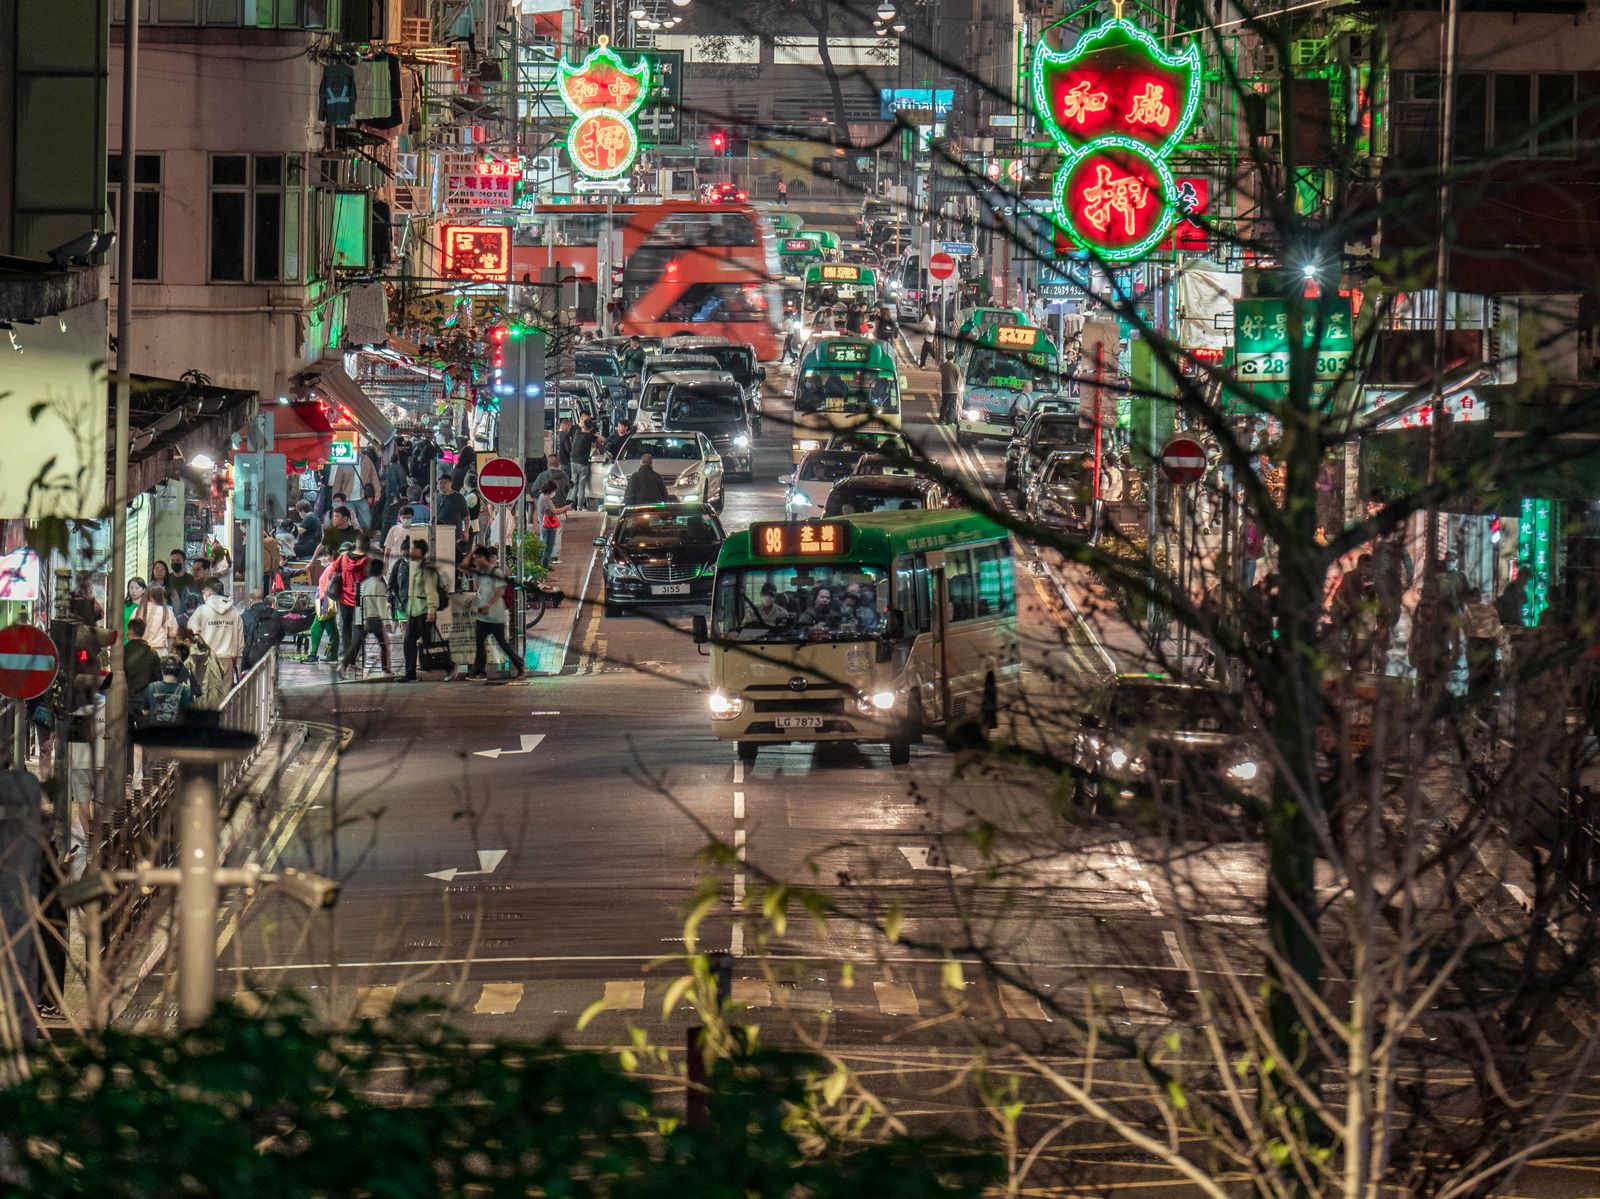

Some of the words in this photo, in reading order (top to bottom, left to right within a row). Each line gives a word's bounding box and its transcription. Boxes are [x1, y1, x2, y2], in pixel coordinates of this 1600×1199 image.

[888, 99, 947, 114] citibank
[580, 120, 626, 167] 押
[1083, 165, 1149, 235] 押
[766, 527, 782, 552] 98
[777, 718, 791, 727] LG
[795, 718, 821, 727] 7873
